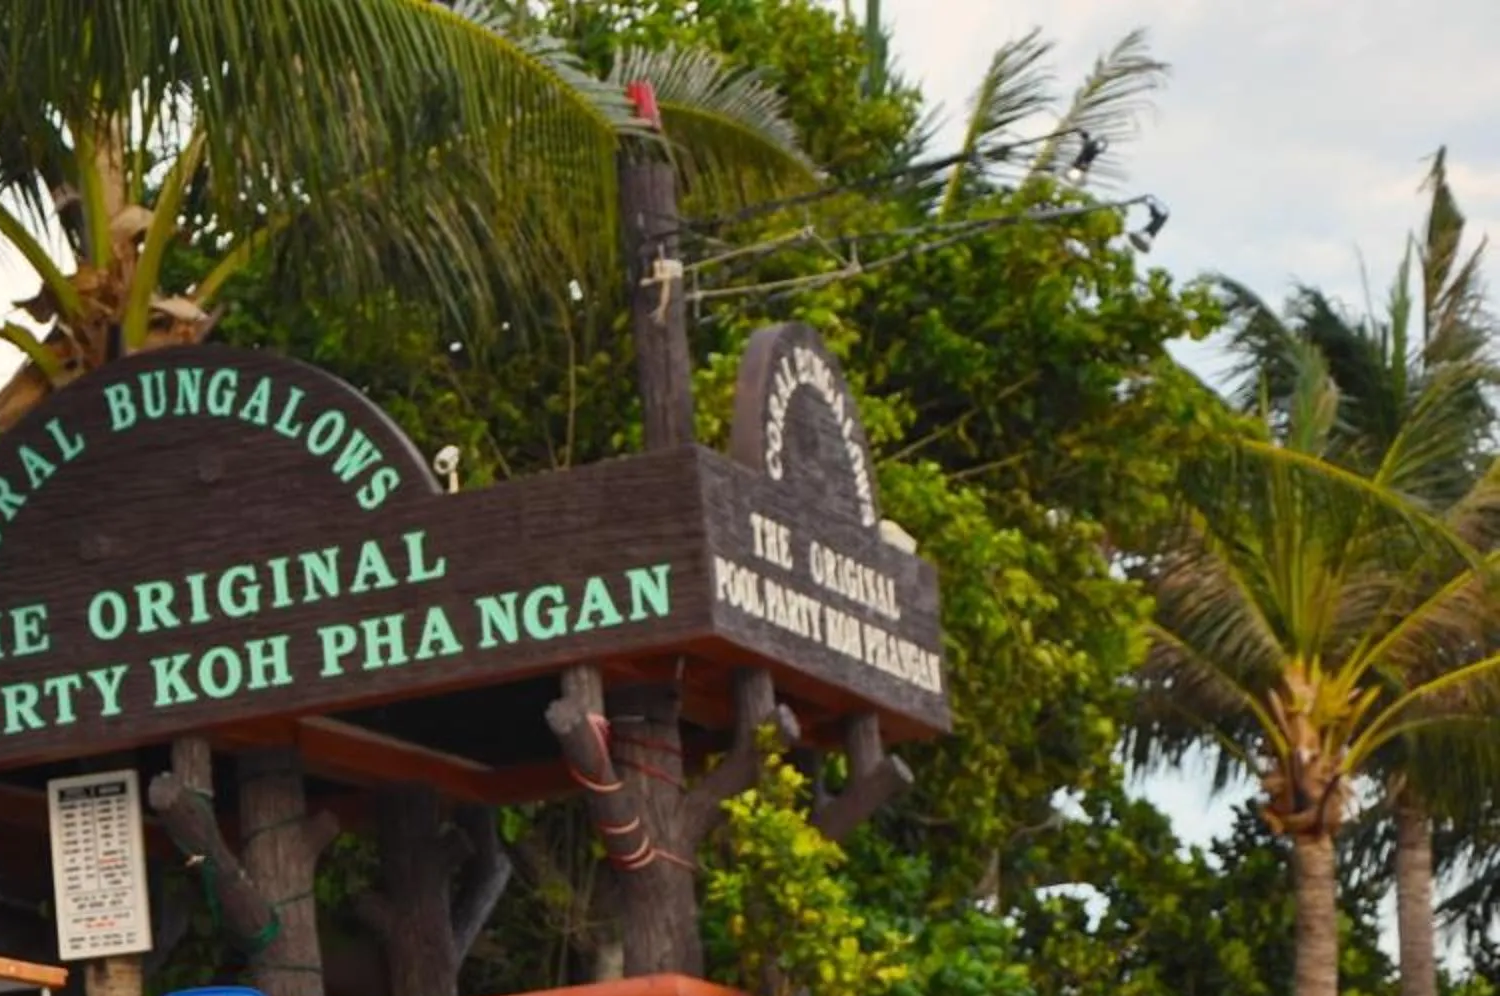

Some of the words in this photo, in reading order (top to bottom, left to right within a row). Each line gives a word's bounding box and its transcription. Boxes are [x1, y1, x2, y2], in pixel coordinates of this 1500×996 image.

[104, 366, 401, 512] BUNGALOWS
[87, 530, 447, 641] ORIGINAL
[714, 555, 765, 619] POOL
[764, 577, 822, 643] PARTY
[824, 605, 863, 661] KOH
[750, 511, 793, 570] THE
[809, 540, 901, 621] ORIGINAL
[149, 633, 294, 706] KOH
